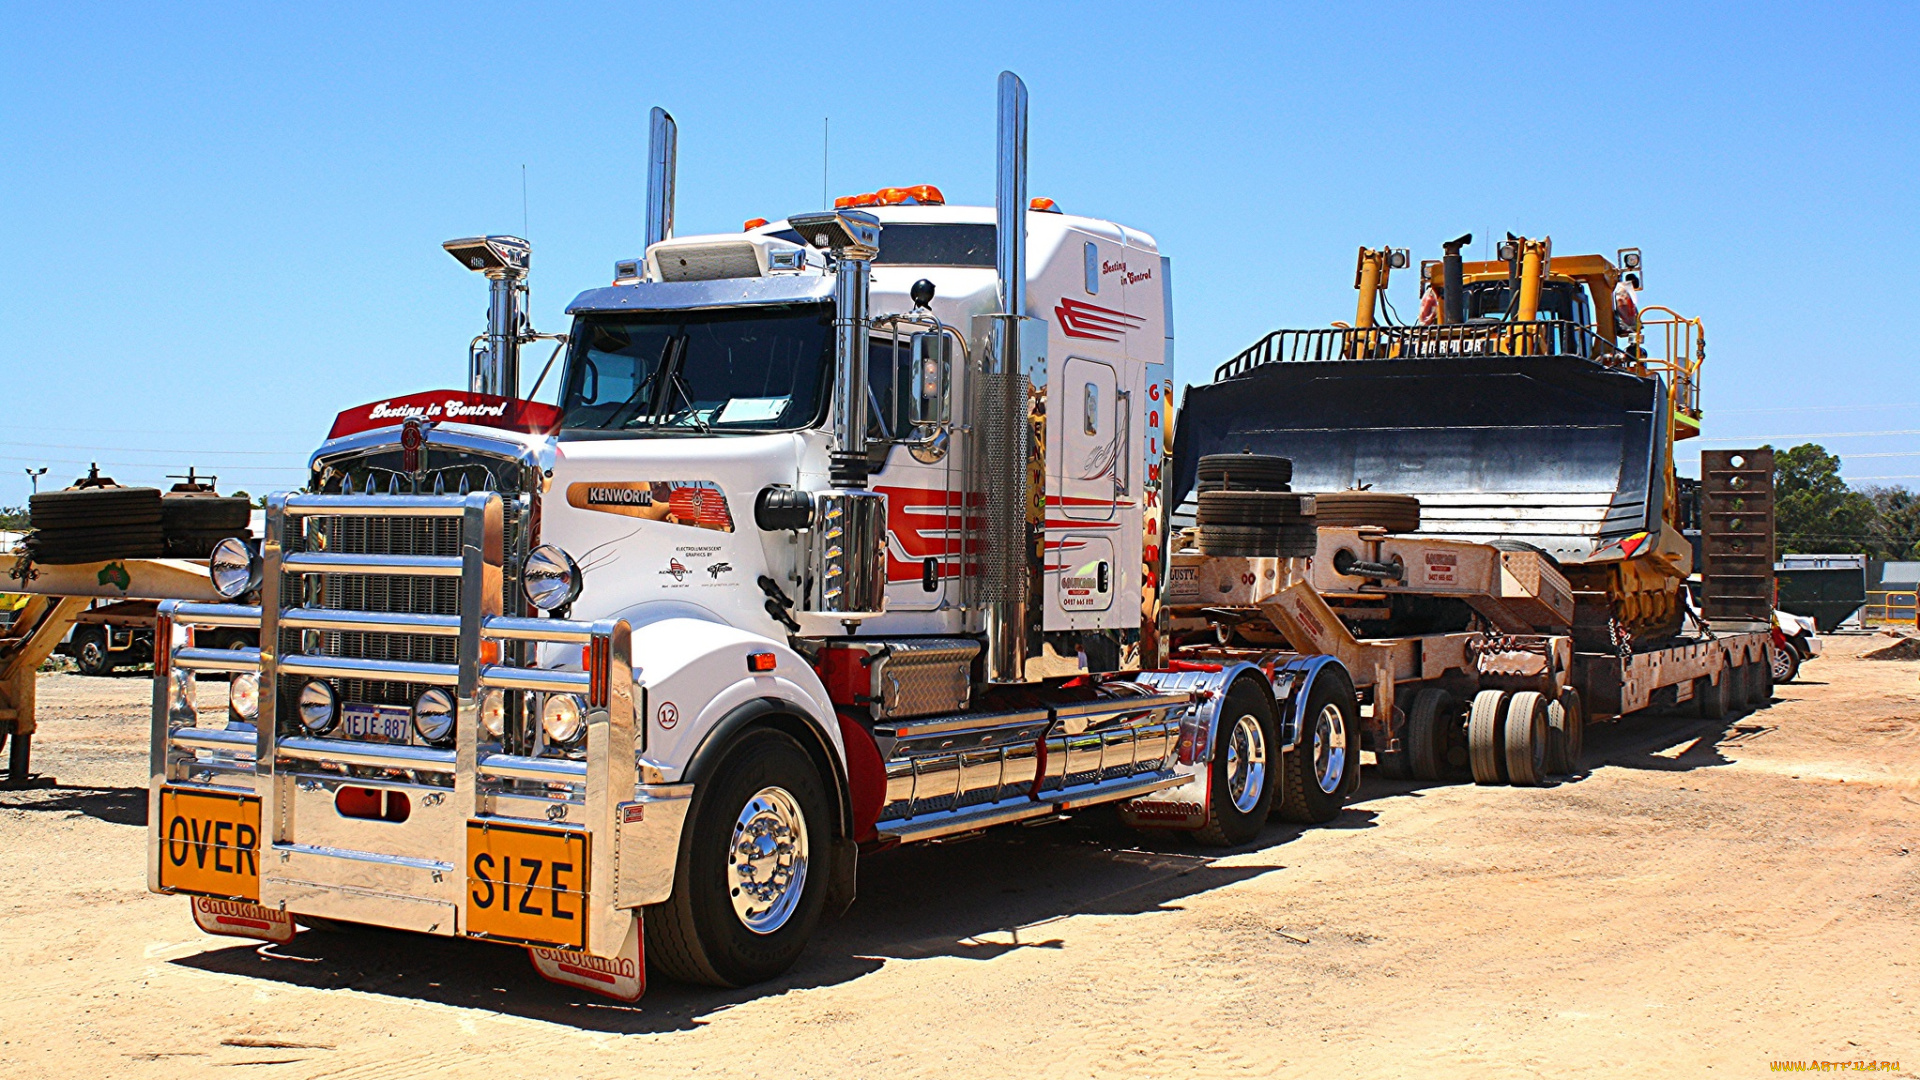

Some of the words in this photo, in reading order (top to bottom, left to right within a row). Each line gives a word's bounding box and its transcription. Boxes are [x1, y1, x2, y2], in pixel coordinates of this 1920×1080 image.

[1102, 260, 1127, 275] Destiny
[1120, 275, 1128, 286] in
[1126, 268, 1152, 285] Control
[368, 401, 425, 420] Destiny
[426, 403, 442, 416] in
[444, 400, 508, 418] Control
[590, 488, 653, 504] KENWORTH
[1170, 568, 1195, 580] LUSTY
[661, 709, 676, 723] 12
[168, 815, 257, 877] OVER
[472, 852, 574, 920] SIZE
